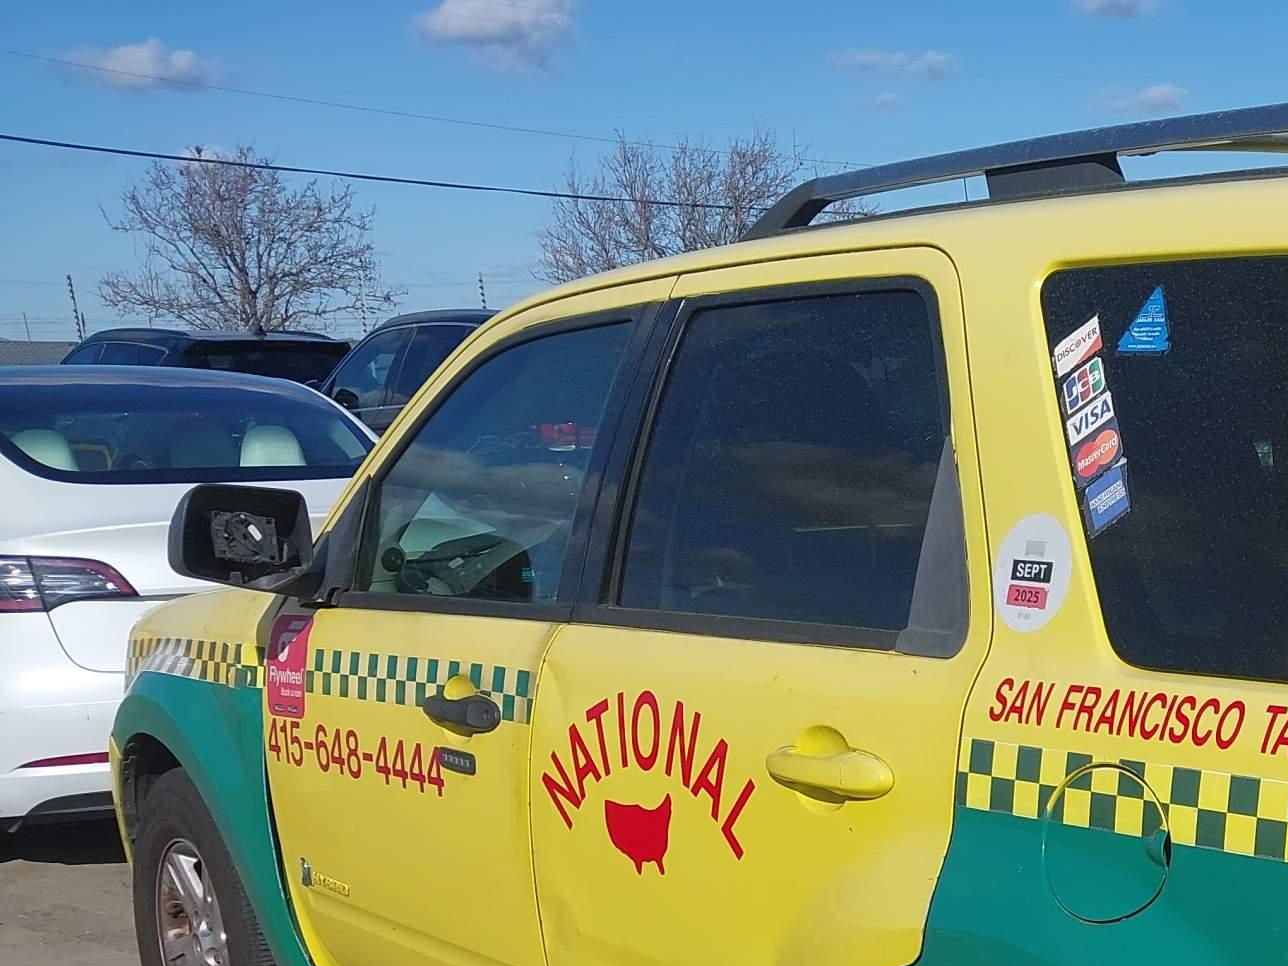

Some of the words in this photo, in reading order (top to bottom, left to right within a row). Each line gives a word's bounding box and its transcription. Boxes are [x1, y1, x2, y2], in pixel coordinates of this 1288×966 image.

[1057, 327, 1098, 362] DISCOVER
[1065, 358, 1104, 412] JCB
[1072, 399, 1112, 437] VISA
[1078, 436, 1119, 472] MasterCard
[1016, 563, 1048, 579] SEPT
[1013, 588, 1041, 604] 2025
[269, 665, 305, 687] Flywheel
[989, 678, 1055, 727] SAN
[1056, 684, 1246, 751] FRANCISCO
[268, 717, 445, 798] 415-648-4444
[541, 689, 757, 862] NATIONAL
